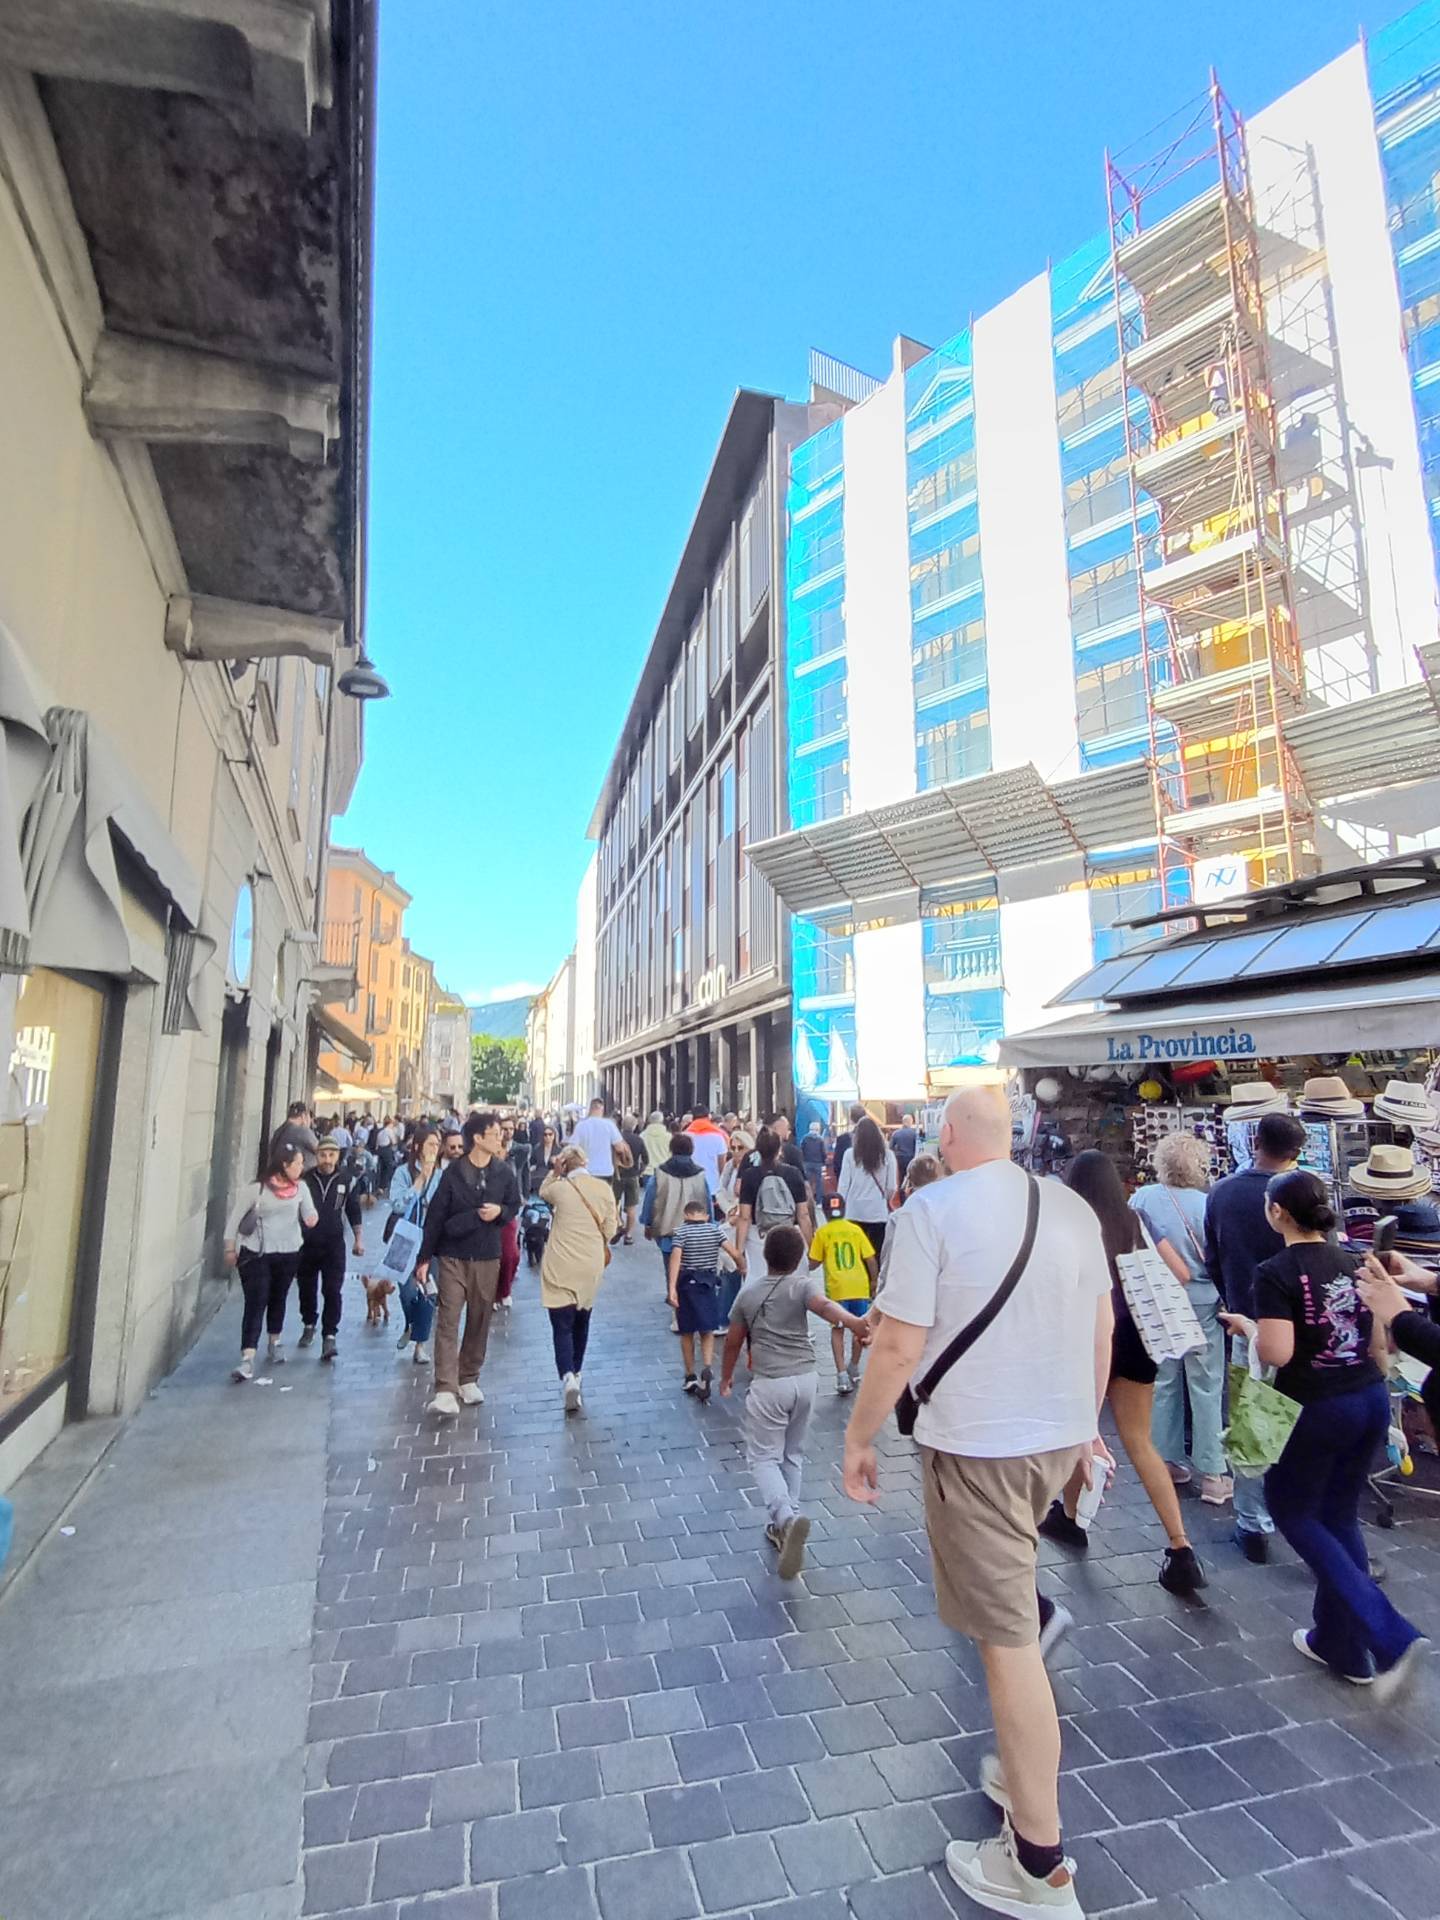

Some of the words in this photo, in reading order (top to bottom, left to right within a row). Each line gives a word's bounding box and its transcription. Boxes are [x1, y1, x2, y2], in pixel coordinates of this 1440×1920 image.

[698, 964, 726, 1008] coin
[1106, 1037, 1133, 1061] La
[1137, 1027, 1256, 1059] Provincia
[833, 1241, 855, 1272] 10
